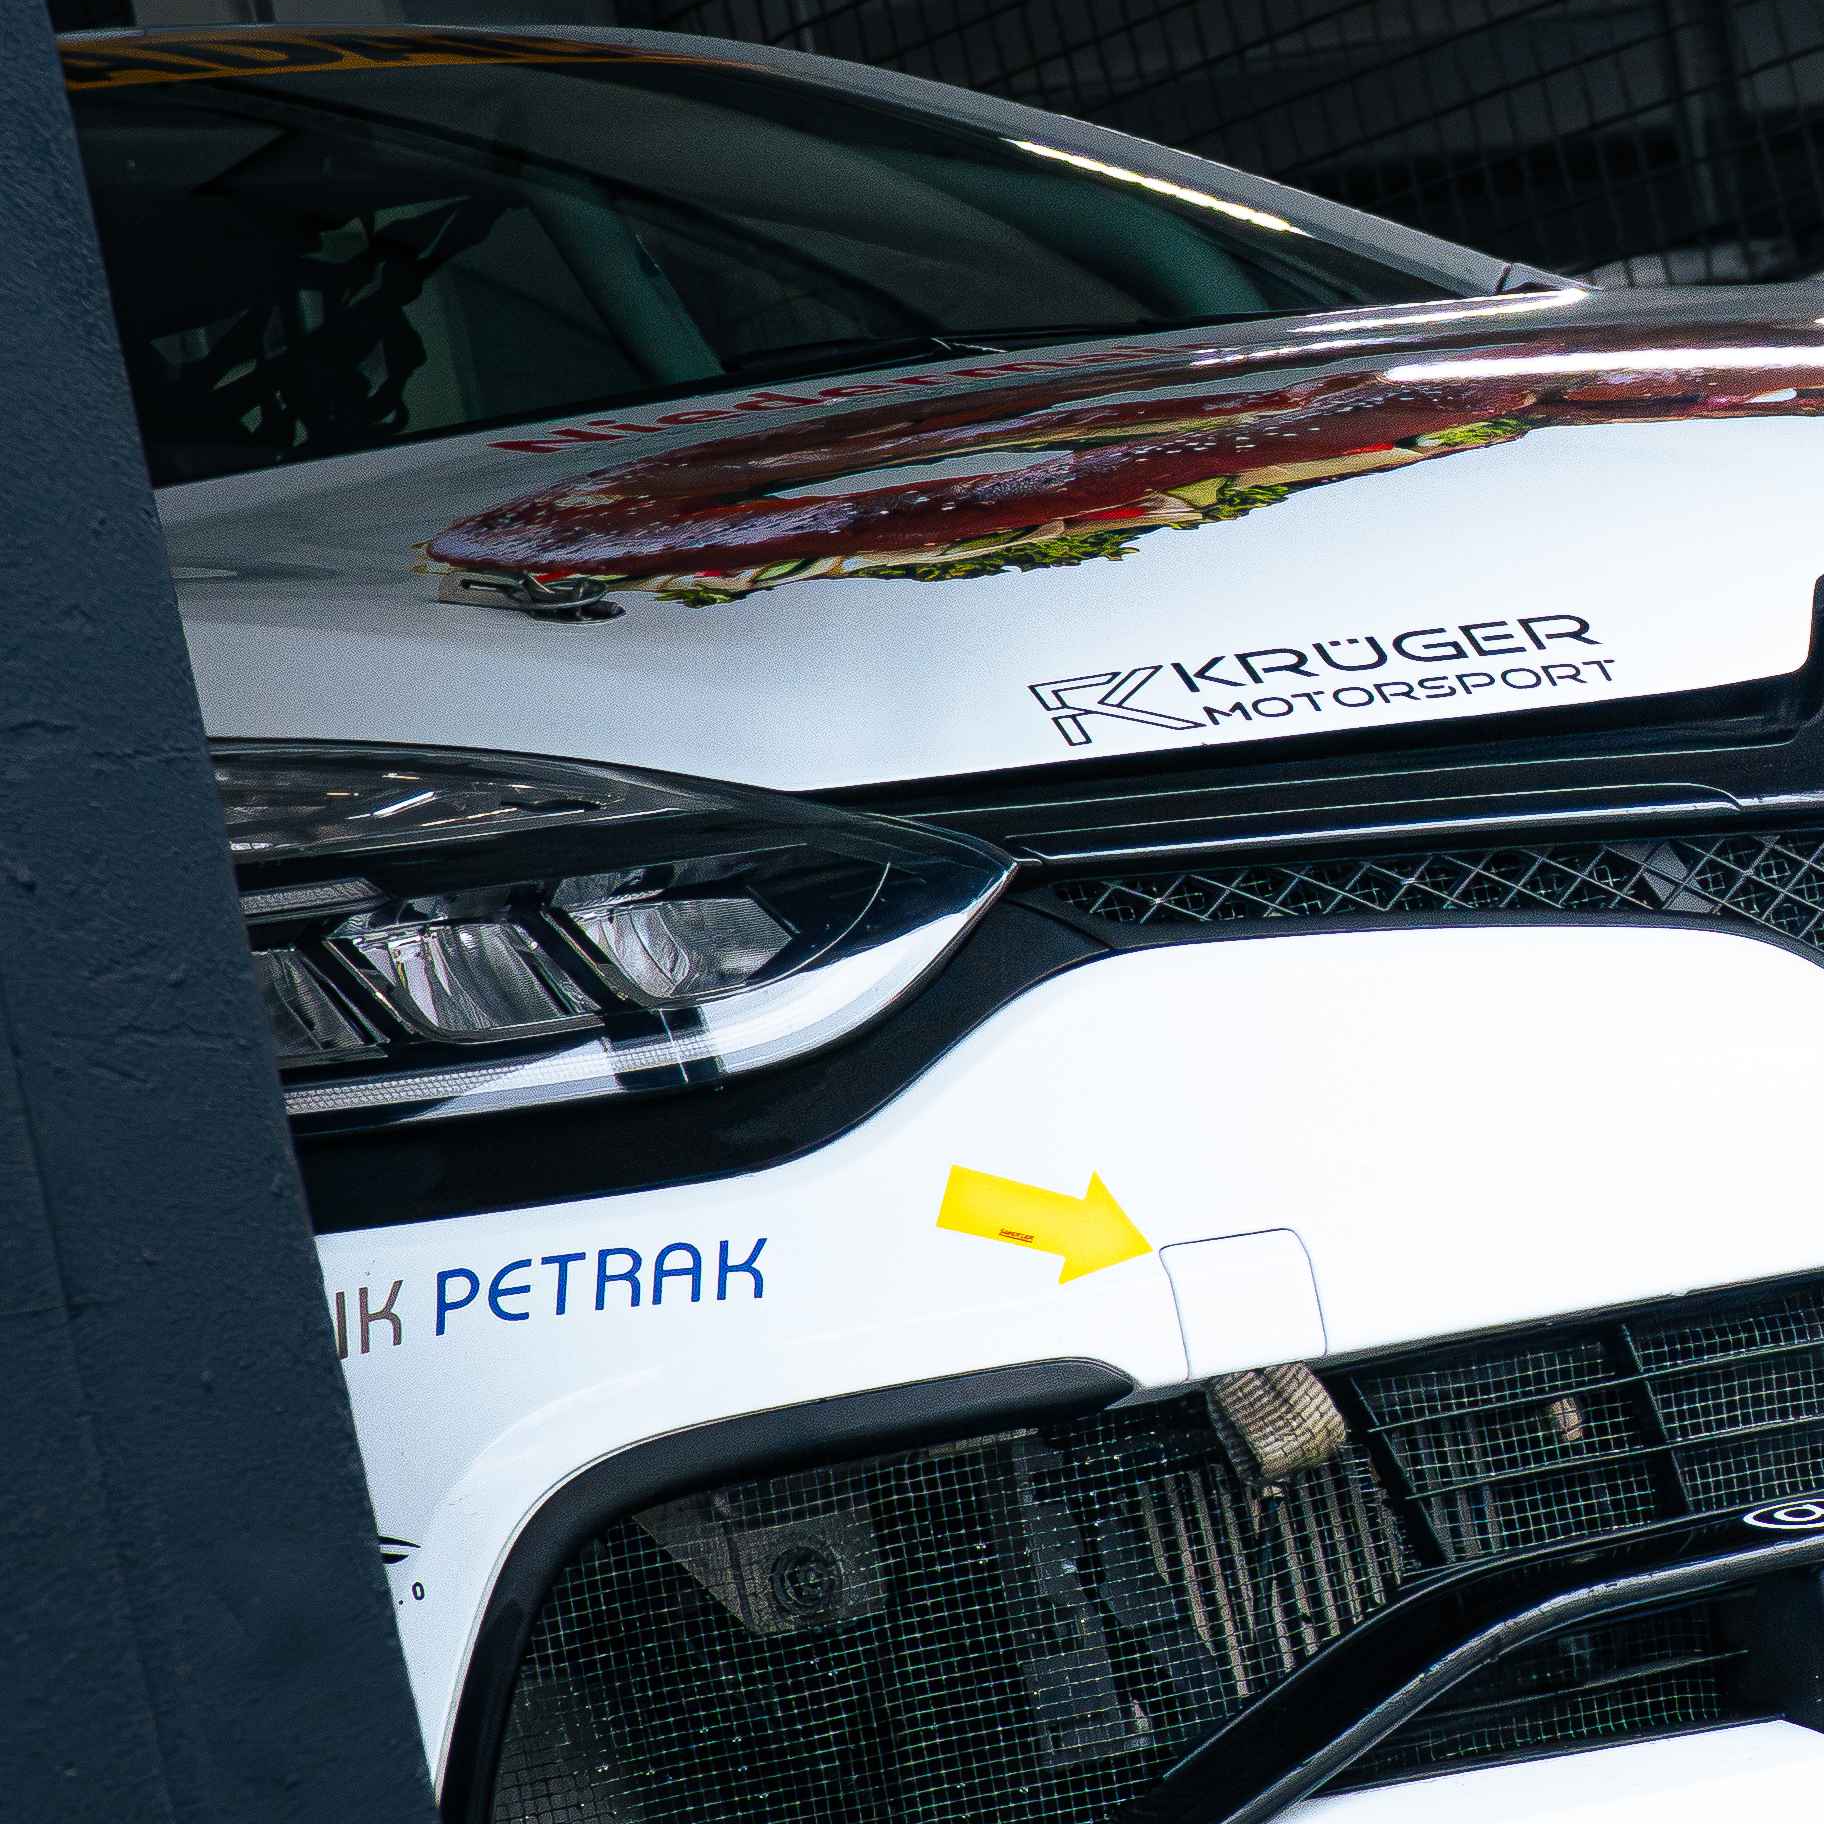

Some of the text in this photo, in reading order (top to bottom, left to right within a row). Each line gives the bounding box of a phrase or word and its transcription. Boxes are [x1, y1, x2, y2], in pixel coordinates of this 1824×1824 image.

[1171, 614, 1603, 693] KRÜGER
[1203, 660, 1616, 725] MOTORSPORT
[435, 1238, 767, 1336] PETRAK
